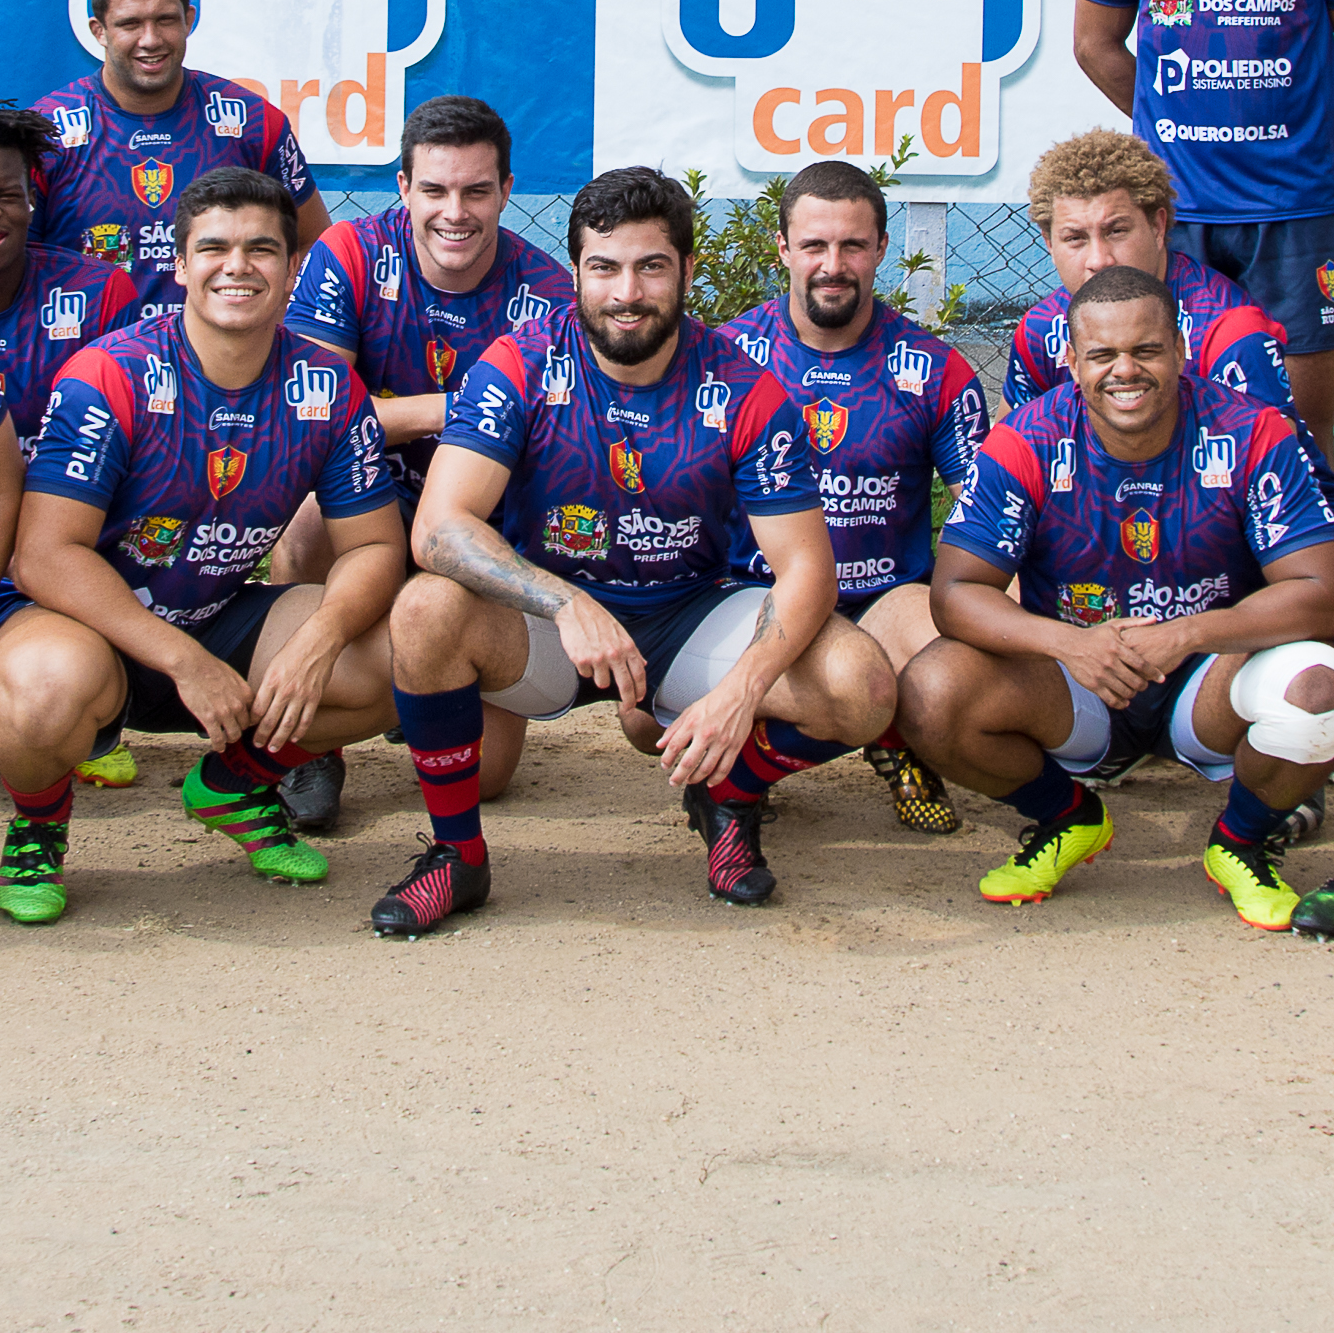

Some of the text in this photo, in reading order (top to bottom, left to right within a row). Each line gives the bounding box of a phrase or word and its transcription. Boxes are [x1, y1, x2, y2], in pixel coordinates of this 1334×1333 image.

[1217, 15, 1281, 27] PREFEITURA
[1192, 57, 1292, 78] POLIEDRO
[1192, 76, 1293, 90] SISTEMA DE ENSINO
[206, 91, 247, 129] dm
[752, 63, 982, 157] card
[135, 132, 171, 142] SANRAD
[1177, 124, 1289, 142] QUERO BOLSA
[282, 133, 307, 192] CNA
[140, 247, 171, 260] DOS
[42, 288, 86, 330] dm
[429, 309, 467, 326] SANRAD
[51, 323, 80, 338] card
[888, 340, 932, 388] dm
[285, 360, 337, 409] dm
[810, 371, 851, 382] SANRAD
[895, 376, 922, 394] card
[215, 411, 255, 423] SANRAD
[299, 403, 330, 419] card
[66, 406, 110, 481] PLANI
[360, 415, 381, 490] CNA
[852, 471, 900, 497] JOSÉ
[1123, 481, 1164, 493] SANRAD
[1202, 471, 1230, 486] card
[840, 495, 897, 513] CAMPOS
[1257, 472, 1289, 548] CNA
[617, 508, 664, 537] SÃO
[616, 534, 652, 551] DOS
[186, 546, 217, 563] DOS
[839, 574, 896, 592] DE ENSINO
[1128, 573, 1230, 607] SÃO JOSÉ
[1166, 590, 1230, 619] CAMPOS
